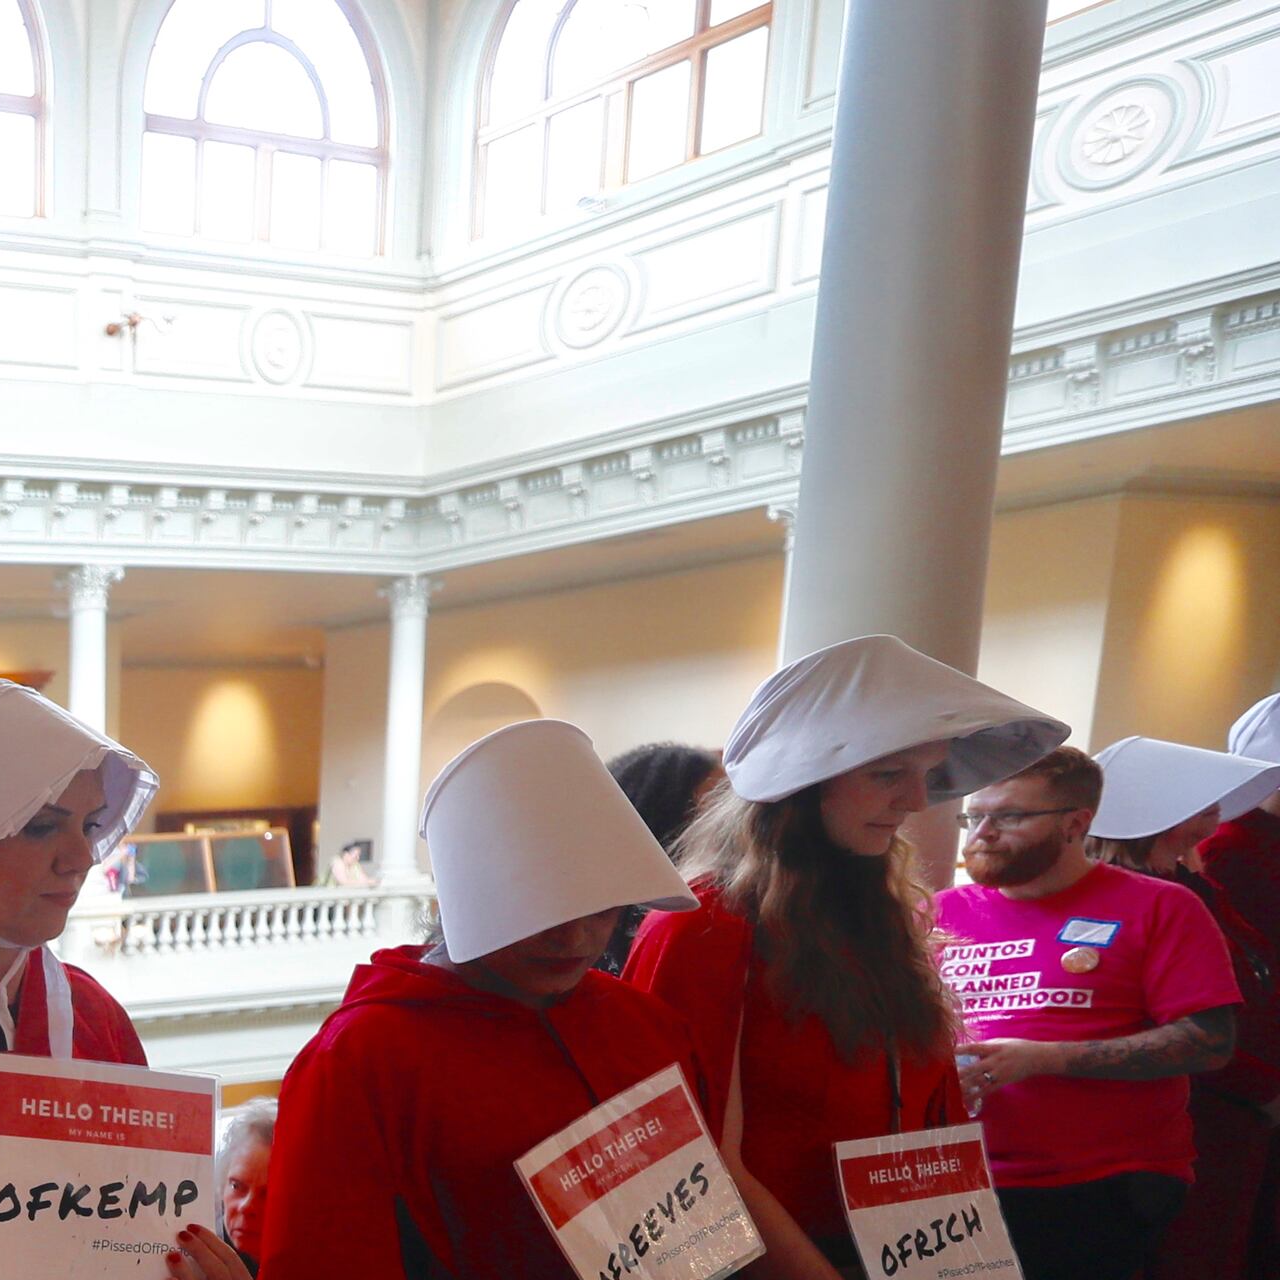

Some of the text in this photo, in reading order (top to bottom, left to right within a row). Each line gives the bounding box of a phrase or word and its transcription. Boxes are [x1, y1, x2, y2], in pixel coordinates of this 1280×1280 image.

[944, 942, 1029, 960] JUNTOS
[942, 963, 987, 977] CON
[949, 975, 1037, 993] LANNED
[963, 991, 1090, 1010] RENTHOOD
[22, 1098, 176, 1129] HELLO THERE!
[68, 1128, 126, 1141] MY NAME IS
[560, 1153, 604, 1192] HELLO
[604, 1117, 663, 1160] THERE!
[869, 1158, 962, 1185] HELLO THERE!
[880, 1204, 984, 1277] OFRICH
